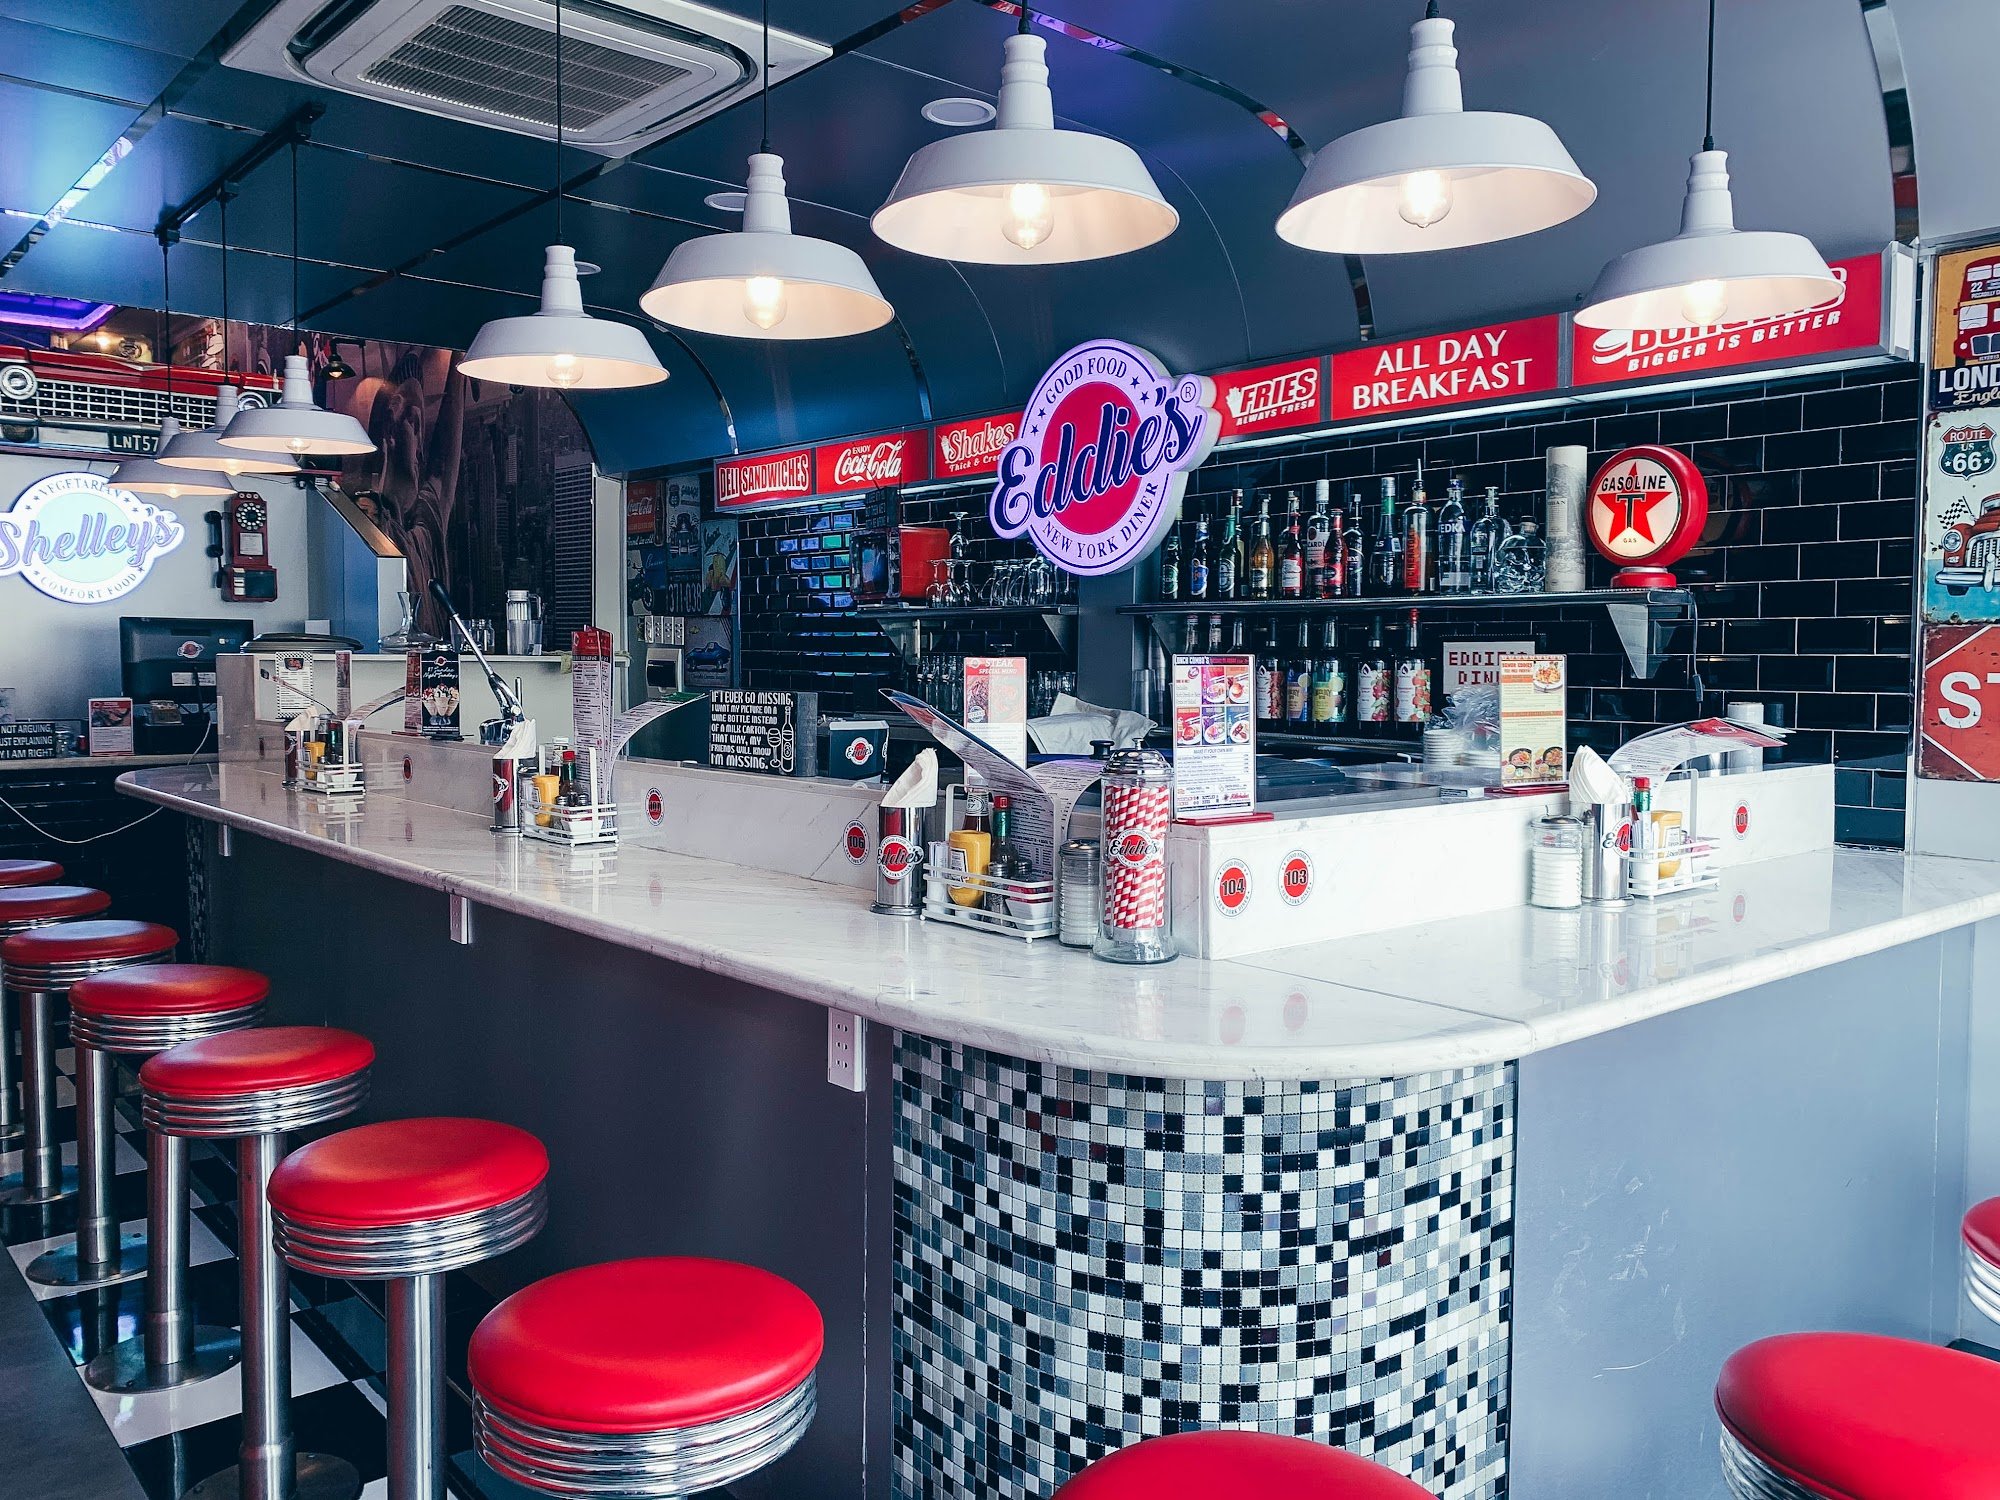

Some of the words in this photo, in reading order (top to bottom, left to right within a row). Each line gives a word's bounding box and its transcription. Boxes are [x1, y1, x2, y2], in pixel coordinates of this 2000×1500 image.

[1971, 281, 1983, 292] 22
[1627, 342, 1707, 372] BIGGER
[1717, 334, 1740, 352] IS
[1751, 310, 1841, 344] BETTER
[1374, 349, 1429, 376] ALL
[1438, 329, 1507, 365] DAY
[1046, 363, 1083, 404] GOOD
[1087, 357, 1127, 379] FOOD
[1352, 358, 1533, 410] BREAKFAST
[1240, 367, 1318, 415] FRIES
[1236, 408, 1277, 426] ALWAYS
[1281, 398, 1315, 415] FRESH
[945, 422, 1015, 464] Shakes
[1950, 429, 1986, 441] ROUTE
[852, 444, 871, 454] ENJOY
[1960, 442, 1975, 451] US
[834, 440, 906, 485] Coca-Cola
[994, 385, 1203, 531] Eddie's
[1952, 451, 1982, 472] 66
[949, 461, 971, 473] Thick
[719, 467, 740, 501] DELI
[741, 454, 809, 493] SANDWICHES
[1601, 475, 1667, 491] GASOLINE
[1616, 493, 1646, 528] T
[1043, 521, 1073, 553] NEW
[1077, 535, 1119, 559] YORK
[1123, 481, 1159, 542] DINER
[0, 507, 179, 569] Shelley's
[108, 573, 138, 594] FOOD
[985, 659, 1014, 667] STEAK
[1458, 671, 1500, 685] DIN
[711, 691, 719, 702] IF
[724, 691, 744, 704] EVER
[745, 692, 755, 704] GO
[757, 692, 794, 707] MISSING,
[715, 704, 730, 712] WANT
[731, 705, 740, 713] MY
[741, 705, 763, 714] PICTURE
[764, 706, 772, 714] ON
[773, 706, 777, 714] A
[711, 714, 726, 722] WINE
[727, 714, 750, 723] BOTTLE
[752, 715, 778, 724] INSTEAD
[1, 725, 17, 734] NOT
[711, 724, 719, 732] OF
[720, 724, 725, 732] A
[726, 725, 741, 733] MILK
[742, 725, 767, 735] CARTON.
[13, 736, 53, 746] EXPLAINING
[711, 734, 728, 743] THAT
[730, 735, 748, 746] WAY,
[750, 736, 761, 745] MY
[11, 749, 26, 759] AM
[711, 744, 735, 753] FRIENDS
[736, 746, 751, 754] WILL
[752, 747, 771, 756] KNOW
[711, 753, 724, 765] I'M
[726, 754, 768, 769] MISSING.
[848, 835, 865, 849] 106
[1285, 869, 1307, 886] 103
[1222, 878, 1244, 896] 104
